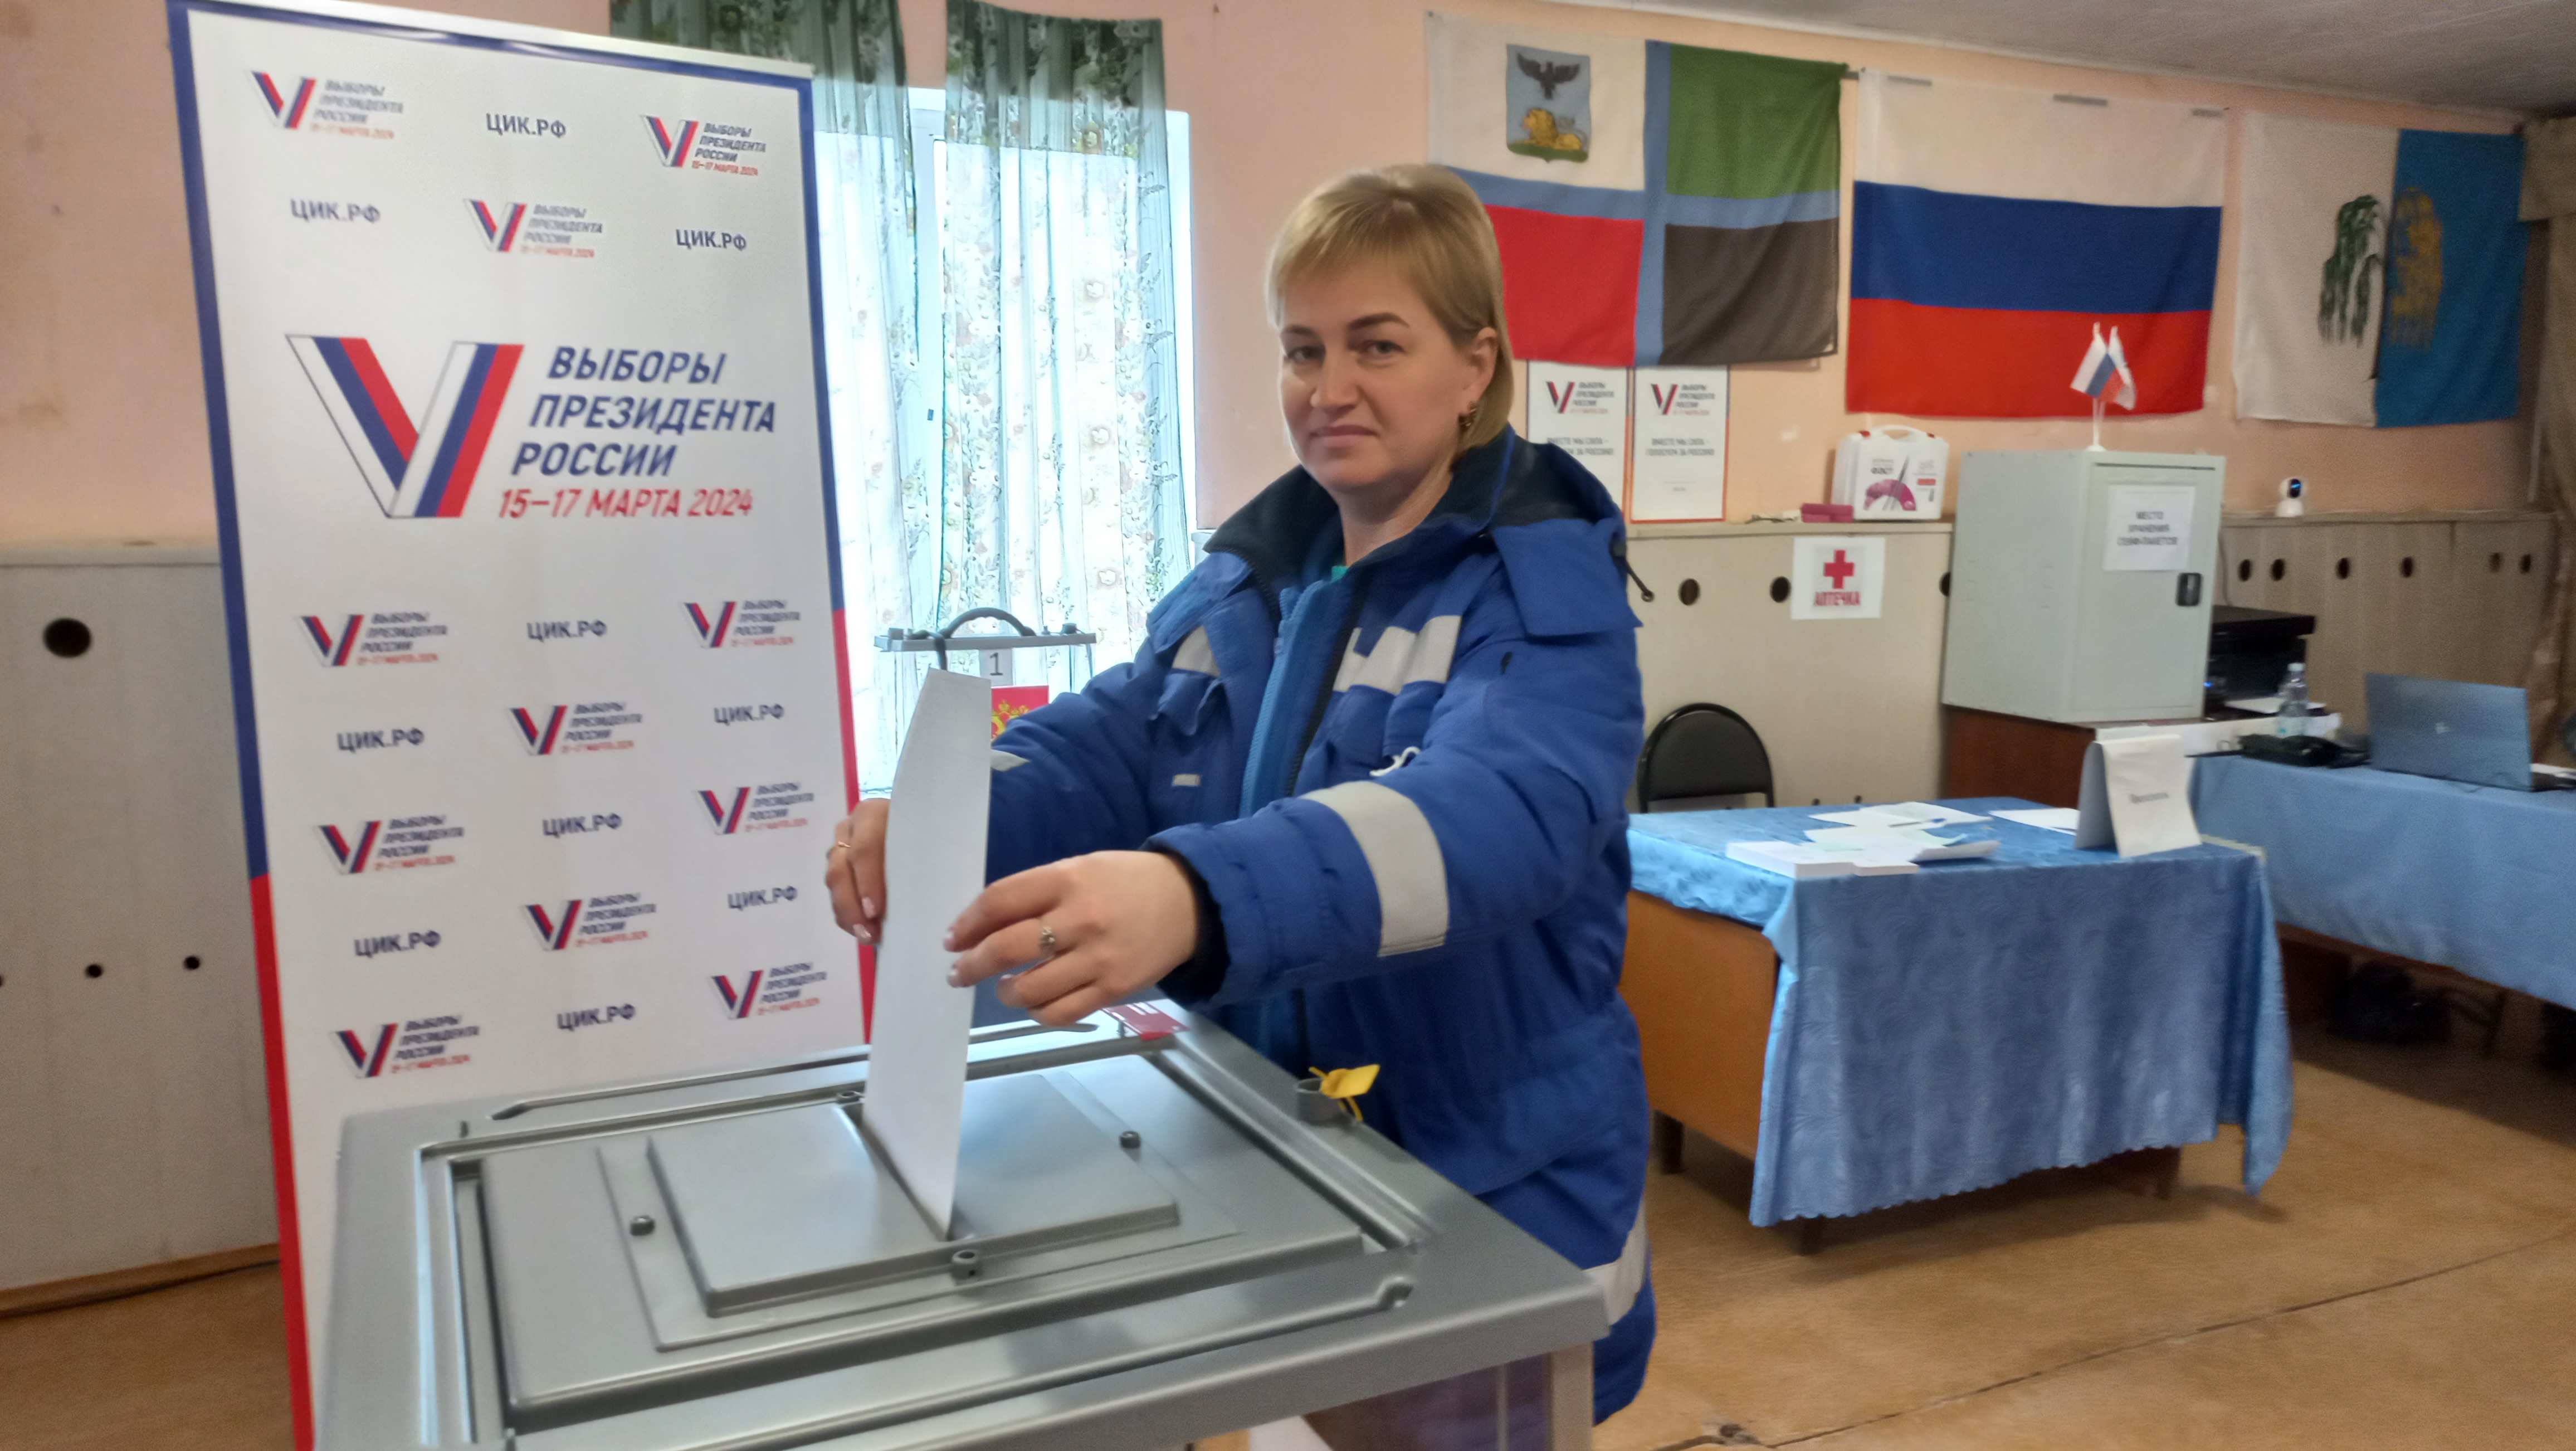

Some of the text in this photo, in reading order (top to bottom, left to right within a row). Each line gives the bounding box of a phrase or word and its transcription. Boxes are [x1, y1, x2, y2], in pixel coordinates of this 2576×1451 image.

[486, 113, 566, 139] ЦИК.РФ
[704, 123, 752, 137] ВЫБОРЫ
[695, 148, 738, 162] РОССИИ
[700, 135, 767, 153] ПРЕЗИДЕНТА
[290, 199, 380, 224] ЦИК.РФ
[676, 229, 747, 251] ЦИК.РФ
[547, 345, 728, 384] ВЫБОРЫ
[530, 394, 777, 435] ПРЕЗИДЕНТА
[511, 442, 677, 476] РОССИИ
[585, 489, 681, 518] МАРТА
[686, 488, 753, 517] 2024
[526, 619, 607, 643] ЦИК.РФ
[989, 652, 1003, 676] 1
[714, 703, 785, 726] ЦИК.РФ
[337, 727, 425, 753] ЦИК.РФ
[542, 812, 623, 839] ЦИК.РФ
[728, 885, 798, 911] ЦИК.РФ
[354, 929, 442, 959] ЦИК.РФ
[557, 1003, 636, 1033] ЦИК.РФ
